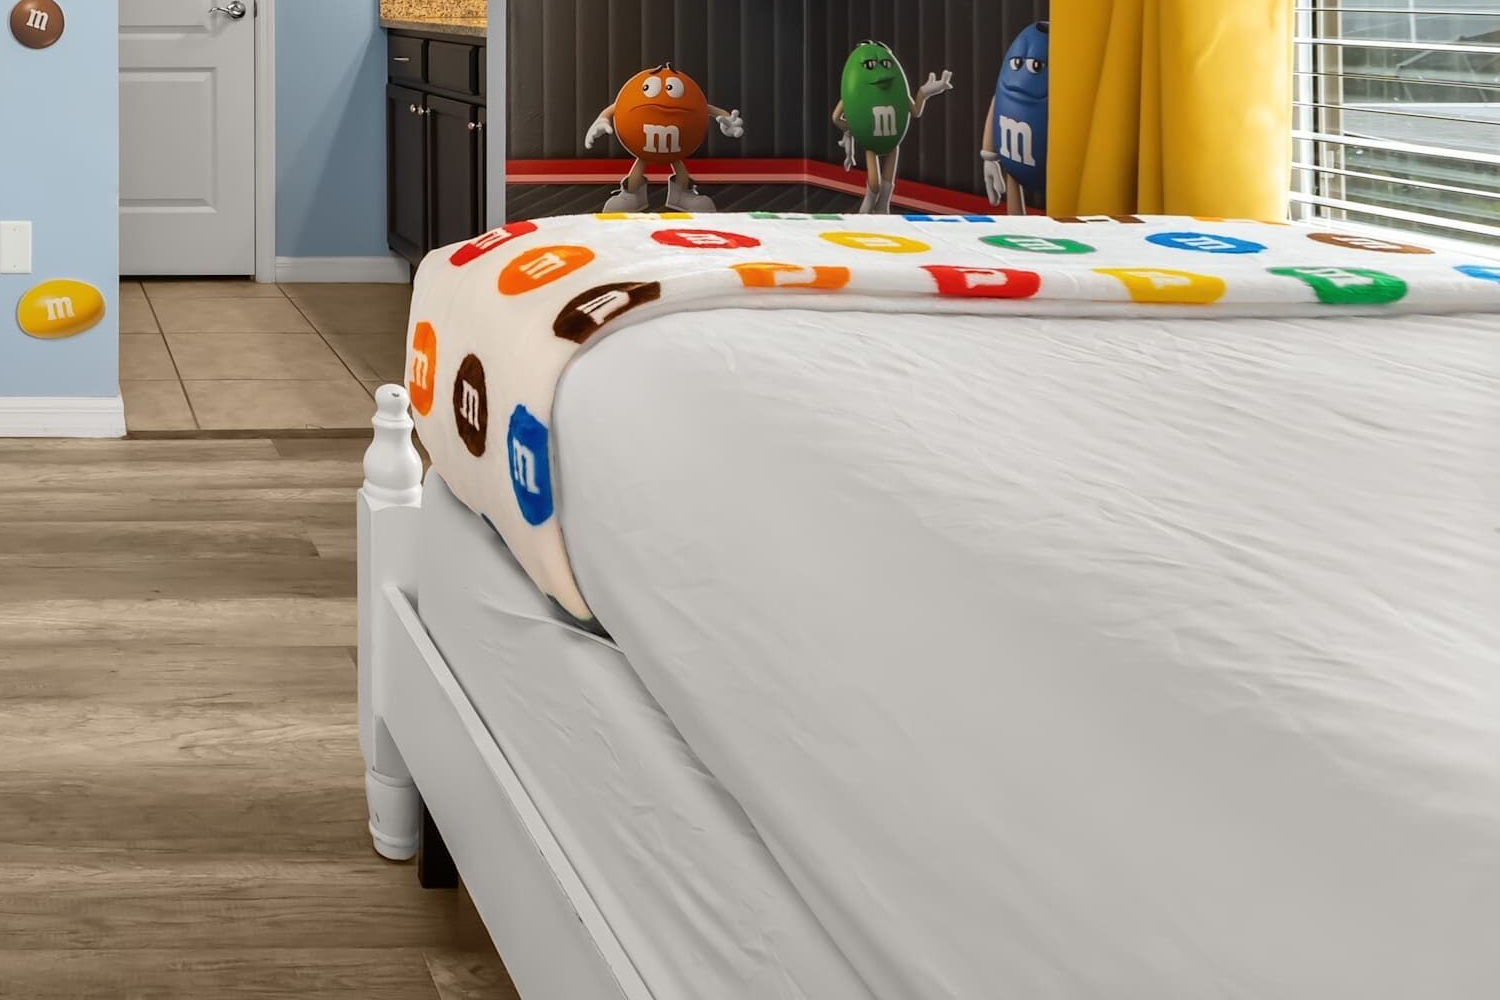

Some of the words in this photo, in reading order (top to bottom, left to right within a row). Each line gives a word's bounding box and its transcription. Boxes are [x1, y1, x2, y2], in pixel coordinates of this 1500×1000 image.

[26, 8, 49, 31] m
[872, 105, 898, 137] m
[643, 124, 681, 154] m
[999, 115, 1036, 167] m
[519, 252, 566, 280] m
[45, 295, 75, 321] m
[460, 379, 480, 431] m
[513, 437, 540, 495] m
